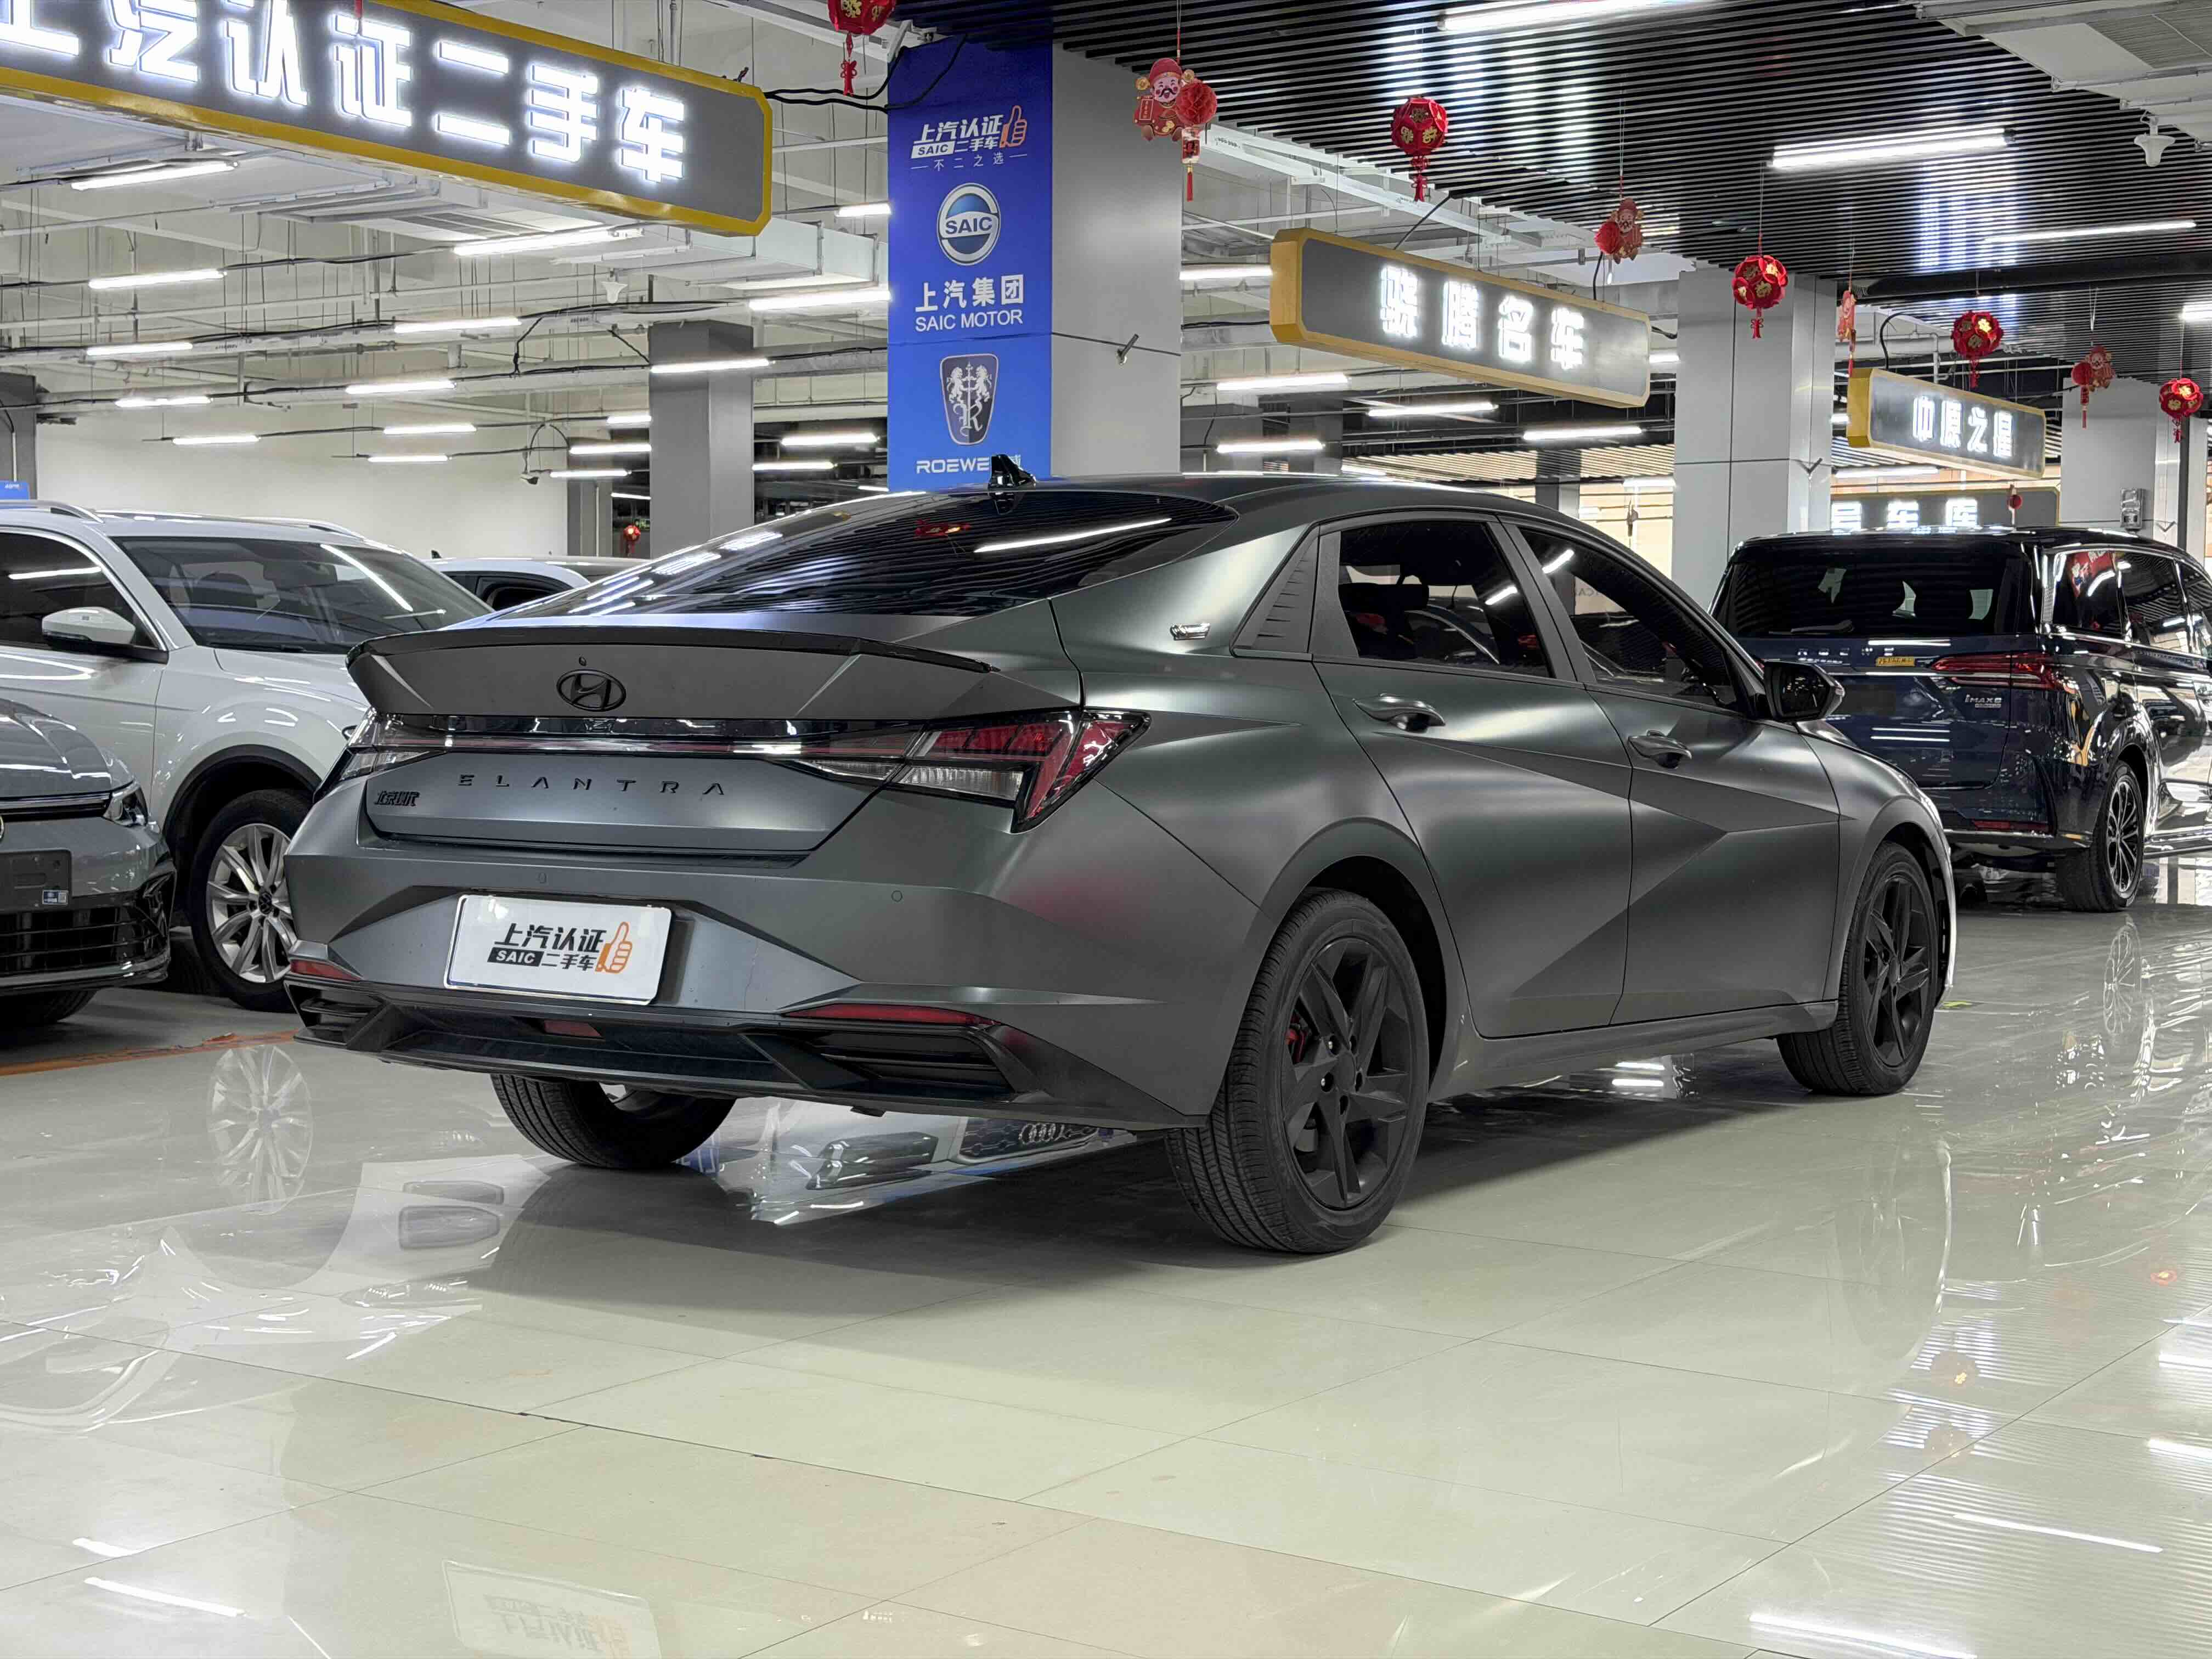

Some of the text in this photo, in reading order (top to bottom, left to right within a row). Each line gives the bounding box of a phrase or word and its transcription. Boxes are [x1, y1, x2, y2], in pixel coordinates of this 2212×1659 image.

[913, 114, 1004, 144] 上汽认证
[918, 136, 999, 156] SAIC 二手车
[934, 151, 1005, 172] 不二之选
[945, 216, 992, 235] SAIC
[915, 274, 1024, 312] 上汽集团
[916, 309, 1023, 332] SAIC MOTOR
[916, 457, 990, 474] ROEWE
[458, 774, 725, 795] ELANTRA
[494, 923, 607, 953] 上汽认证
[496, 950, 598, 971] SAIC 二手车
